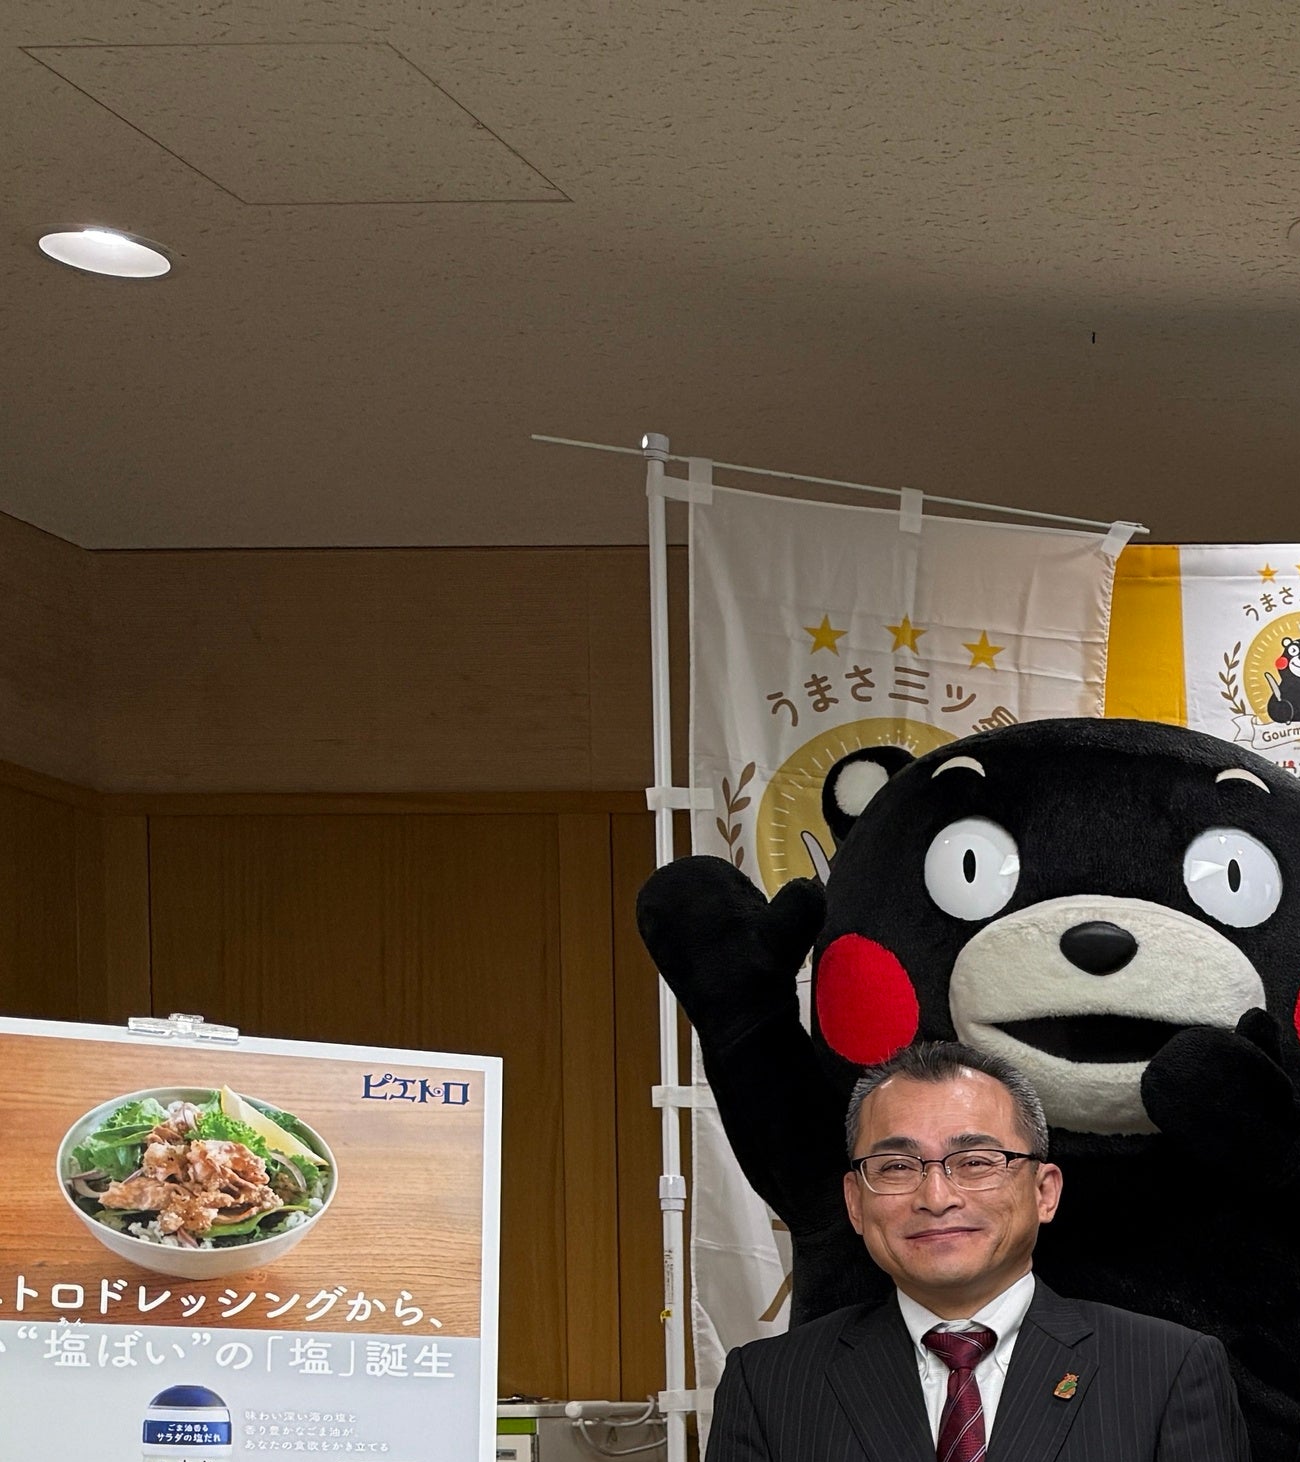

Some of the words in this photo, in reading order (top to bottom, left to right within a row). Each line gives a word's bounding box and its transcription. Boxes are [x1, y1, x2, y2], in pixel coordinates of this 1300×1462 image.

[362, 1073, 470, 1106] ピエトロ
[0, 1275, 443, 1328] トロドレッシングから、
[157, 1432, 222, 1443] サラダの塩だれ
